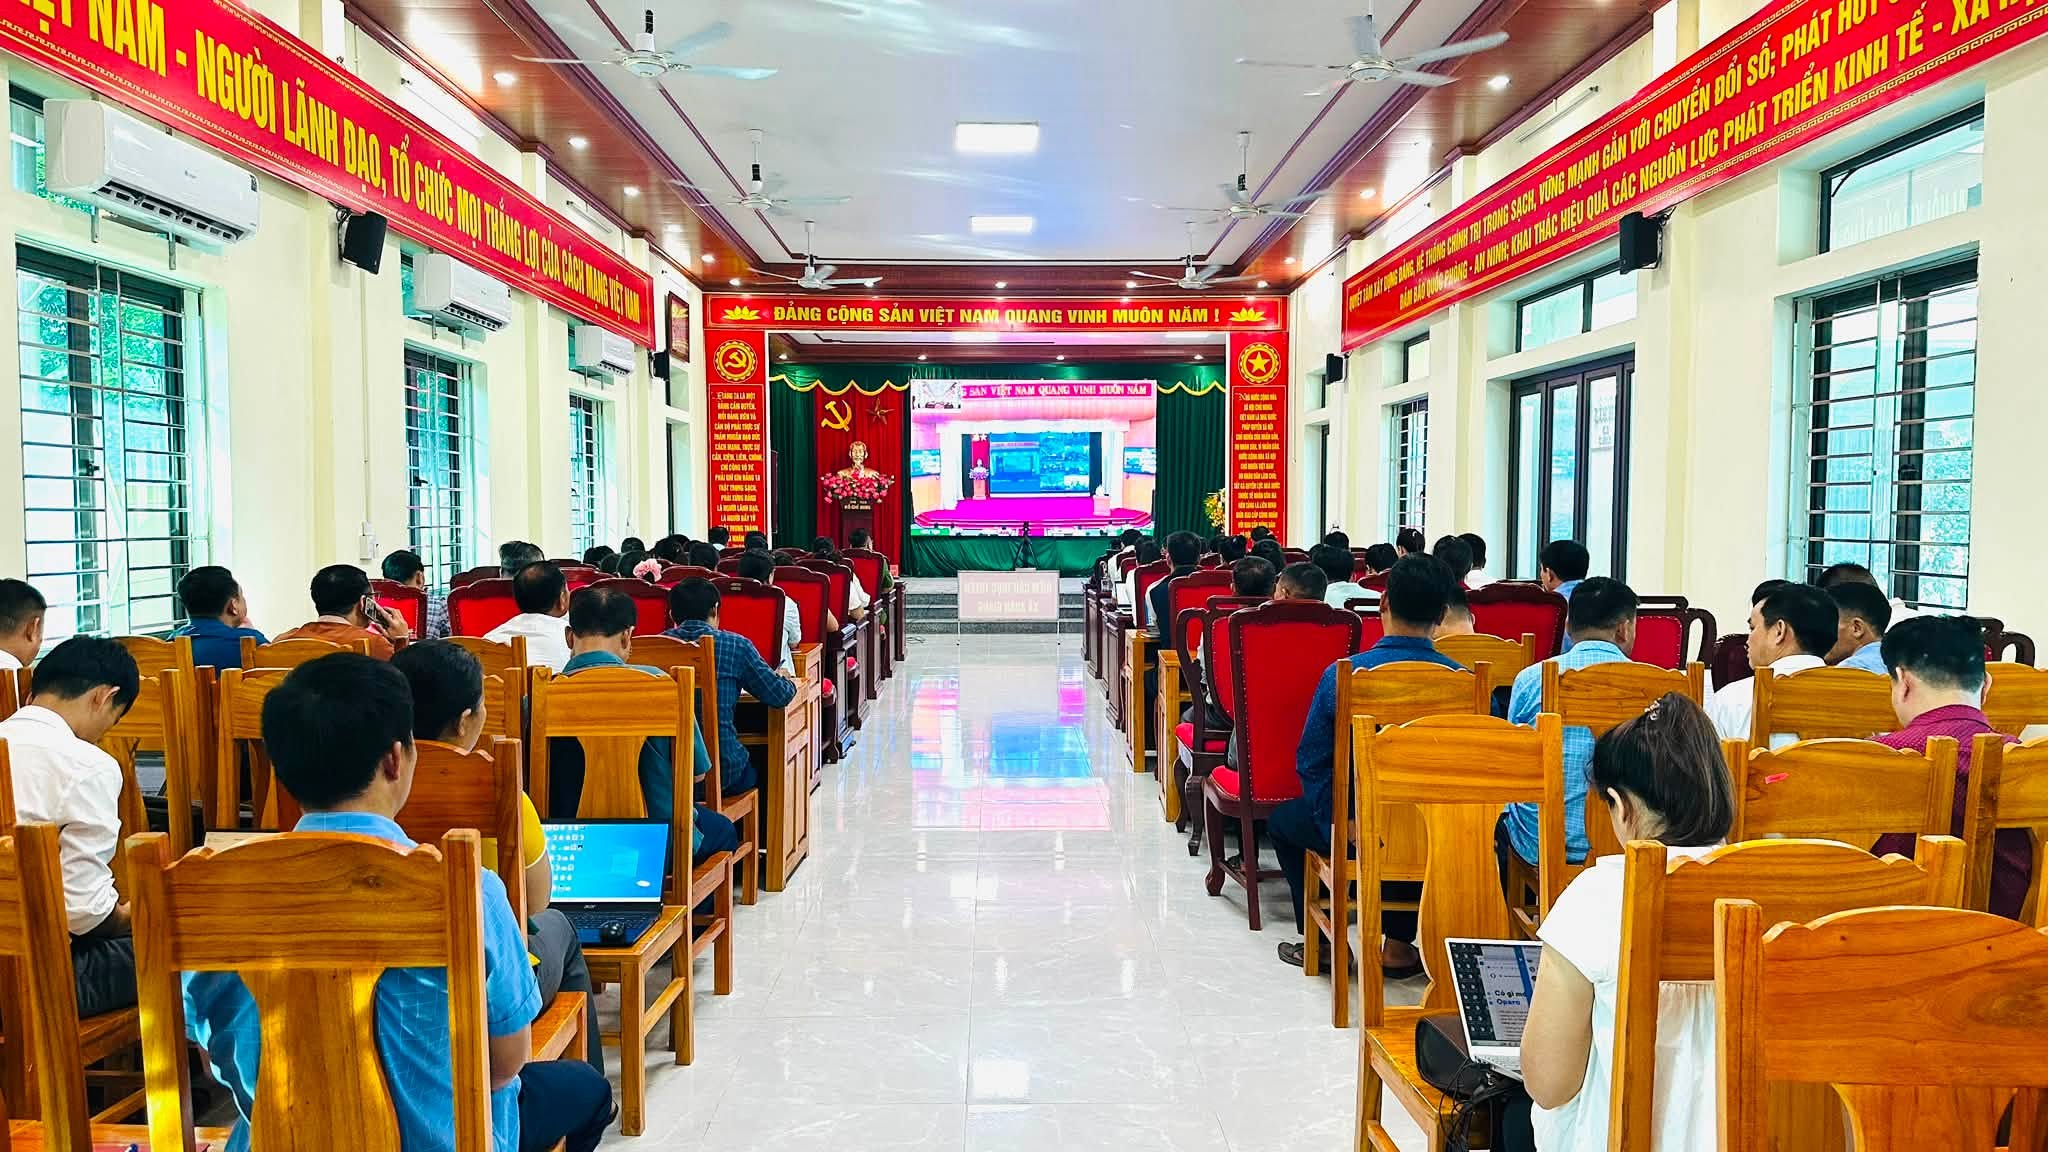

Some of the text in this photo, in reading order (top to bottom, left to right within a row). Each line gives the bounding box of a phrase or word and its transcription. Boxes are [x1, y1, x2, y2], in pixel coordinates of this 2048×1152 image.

[88, 0, 167, 77] NAM
[195, 29, 276, 134] NGƯỜI
[282, 77, 339, 166] LÃNH
[343, 117, 387, 198] ĐẠO,
[389, 133, 411, 204] TỔ
[414, 159, 454, 226] CHỨC
[456, 185, 482, 249] MỌI
[484, 196, 522, 263] THẮNG
[523, 225, 539, 278] LỢI
[541, 224, 561, 282] CỦA
[561, 244, 585, 296] CÁCH
[585, 263, 609, 311] MẠNG
[609, 273, 624, 321] VIỆT
[624, 286, 641, 325] NAM
[1416, 249, 1425, 274] HỆ
[1425, 241, 1446, 268] THỐNG
[1447, 226, 1469, 256] CHÍNH
[1469, 219, 1481, 244] TRỊ
[1482, 203, 1509, 237] TRONG
[1510, 188, 1537, 223] SẠCH,
[1539, 170, 1565, 206] VỮNG
[1567, 149, 1600, 189] MẠNH
[1602, 130, 1627, 170] GẮN
[1630, 117, 1651, 155] VỚI
[1653, 77, 1711, 140] CHUYỂN
[1714, 54, 1742, 106] ĐỔI
[1746, 34, 1776, 87] SỐ;
[1781, 9, 1833, 68] PHÁT
[1444, 260, 1468, 289] PHÒNG
[1473, 250, 1486, 275] AN
[1486, 239, 1510, 269] NINH;
[1511, 226, 1532, 257] KHAI
[1533, 211, 1558, 246] THÁC
[1560, 199, 1584, 233] HIỆU
[1586, 178, 1609, 221] QUẢ
[1612, 171, 1637, 207] CÁC
[1639, 141, 1687, 193] NGUỒN
[1690, 127, 1719, 169] LỰC
[1723, 101, 1768, 151] PHÁT
[1771, 61, 1829, 126] TRIỂN
[1833, 34, 1889, 95] KINH
[1895, 1, 1927, 62] TẾ
[774, 301, 1220, 325] ĐẢNG CỘNG SẢN VIỆT NAM QUANG VINH MUÔN NĂM !
[1015, 385, 1035, 395] NAM
[1038, 385, 1070, 396] QUANG
[1073, 385, 1096, 395] VINH
